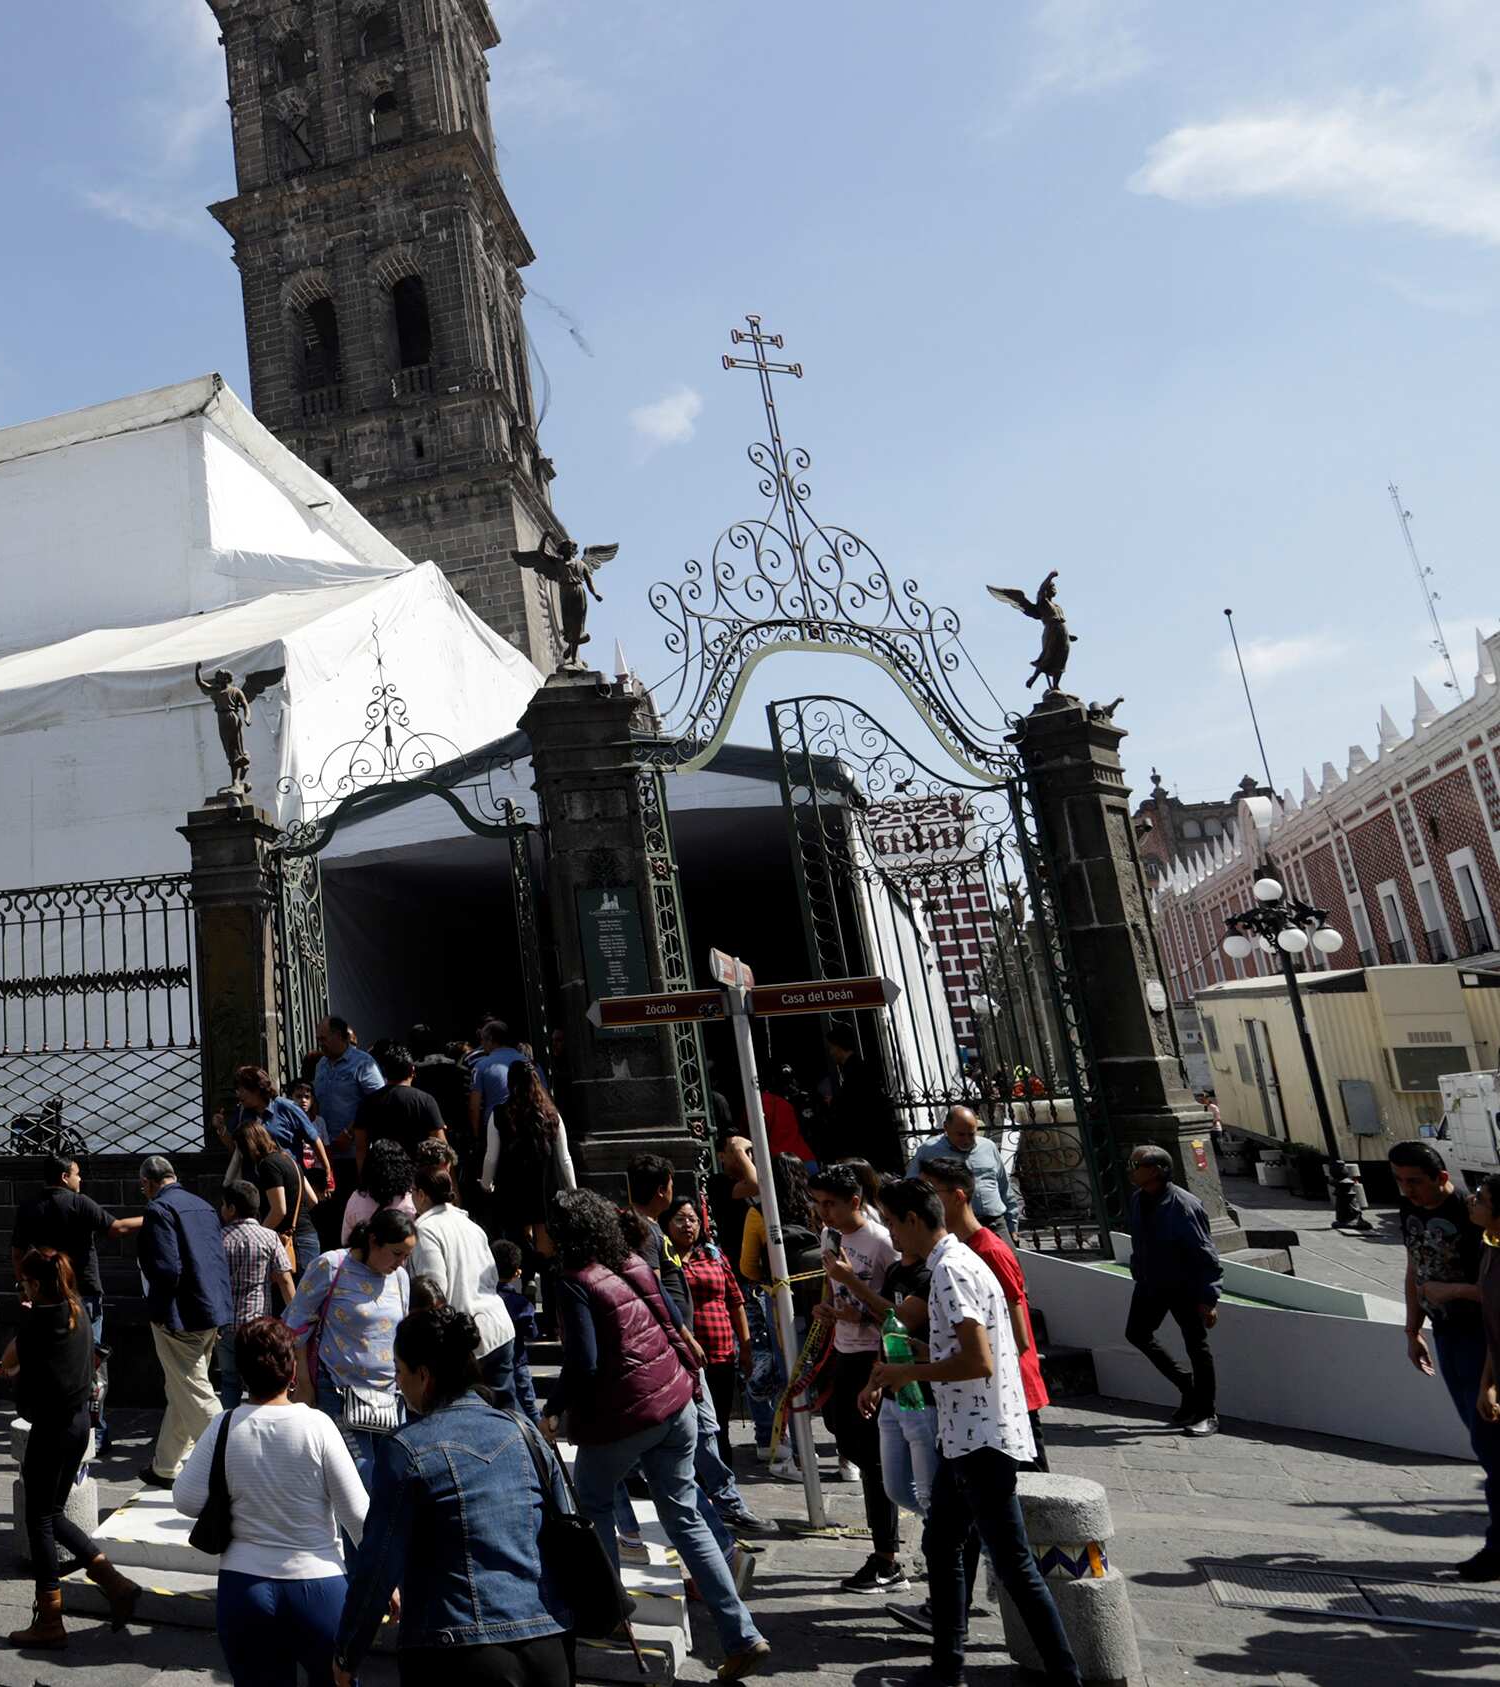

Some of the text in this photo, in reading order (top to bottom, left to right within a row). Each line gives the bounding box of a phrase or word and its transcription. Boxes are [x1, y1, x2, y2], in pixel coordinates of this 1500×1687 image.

[781, 988, 854, 1004] Casa del Deán
[645, 1003, 677, 1015] Zócalo
